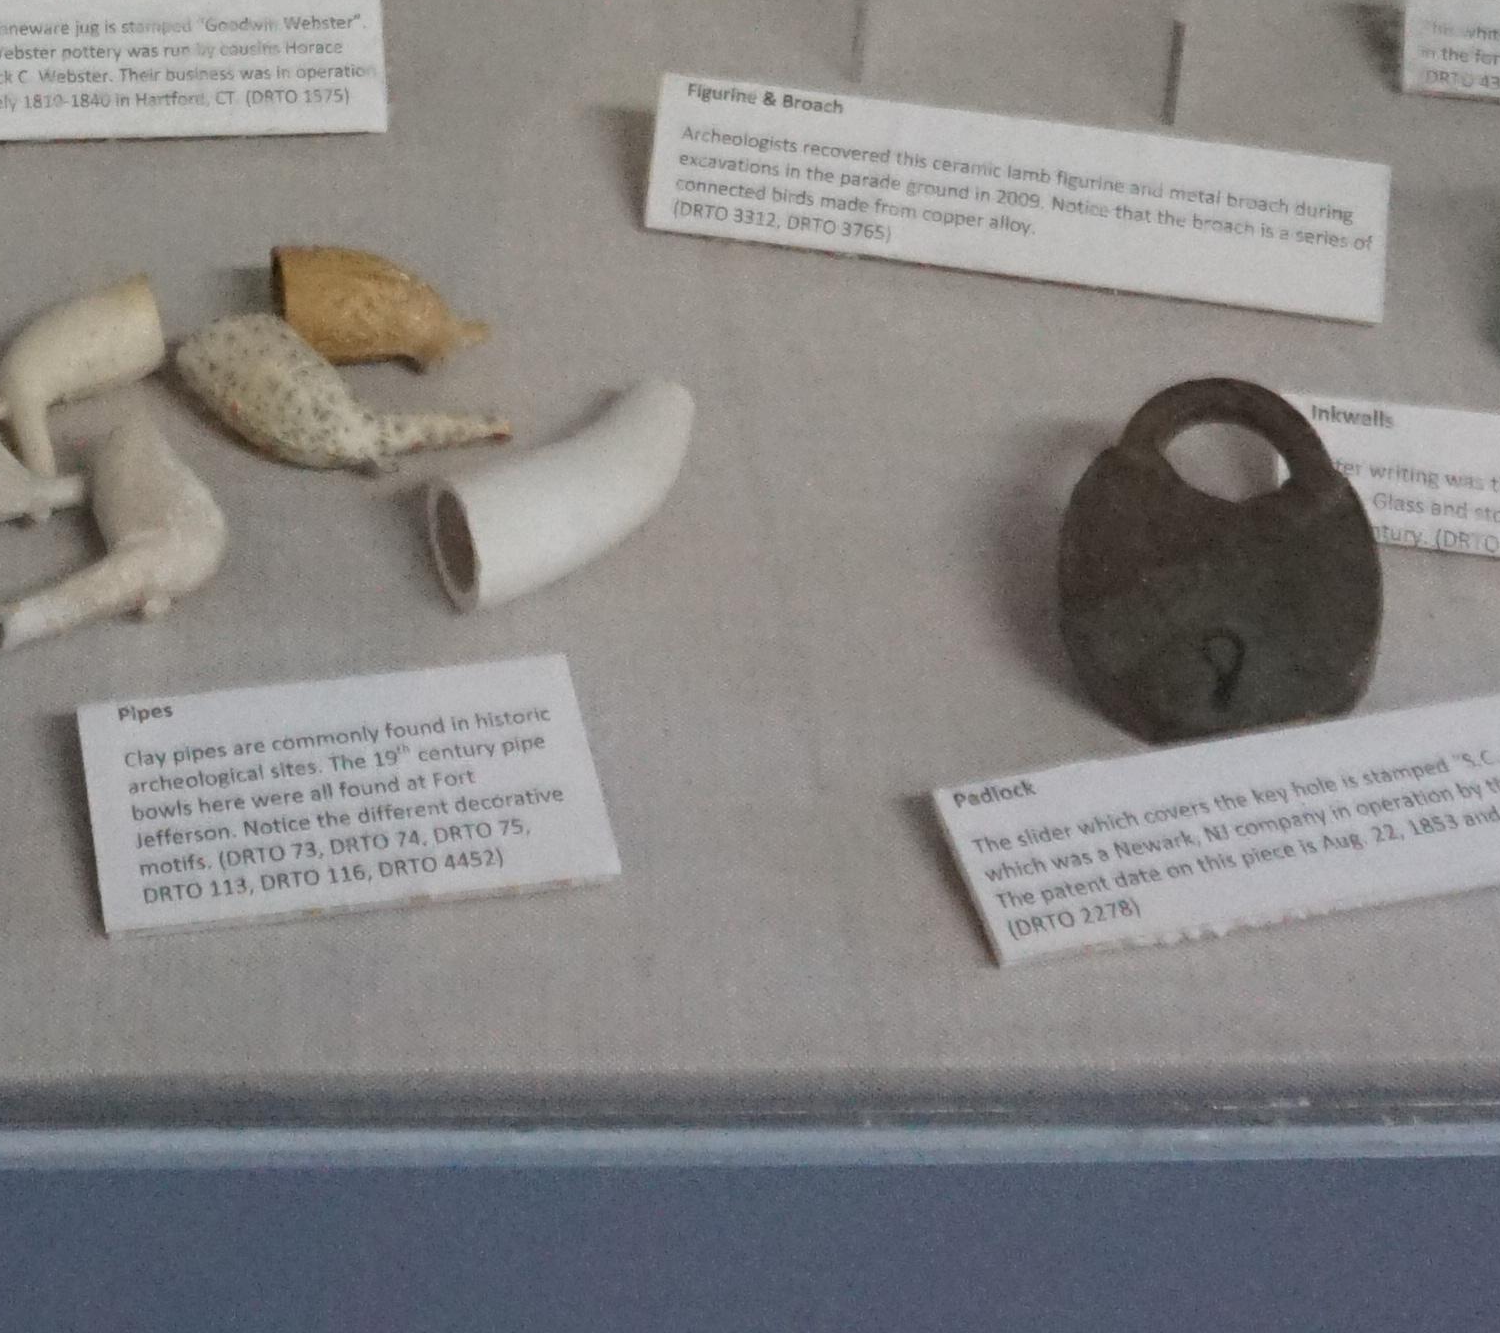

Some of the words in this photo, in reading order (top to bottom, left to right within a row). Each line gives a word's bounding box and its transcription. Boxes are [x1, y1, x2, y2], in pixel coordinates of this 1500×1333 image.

[685, 80, 757, 104] Figurine
[761, 89, 778, 107] &
[780, 91, 845, 115] Broach
[673, 177, 768, 201] connected
[769, 184, 815, 207] birds
[818, 193, 870, 213] made
[872, 197, 918, 219] from
[920, 207, 983, 229] copper
[987, 212, 1035, 237] alloy.
[116, 703, 174, 723] Pipes
[122, 749, 168, 769] Clay
[171, 744, 228, 767] pipes
[231, 740, 266, 756] are
[270, 724, 380, 752] commonly
[383, 715, 446, 739] found
[449, 715, 470, 732] in
[473, 705, 551, 729] historic
[129, 798, 193, 821] bowls
[196, 795, 246, 814] here
[249, 789, 305, 808] were
[309, 781, 334, 801] all
[337, 774, 401, 798] found
[405, 774, 427, 791] at
[431, 768, 476, 788] Fort
[950, 777, 1036, 807] Padlock
[141, 883, 204, 906] DRTO
[209, 878, 254, 898] 113,
[259, 870, 321, 893] DRTO
[327, 864, 373, 885] 116,
[376, 856, 439, 879] DRTO
[442, 848, 505, 872] 4452)
[1006, 911, 1077, 943] (DRTO
[1081, 899, 1142, 926] 2278)
